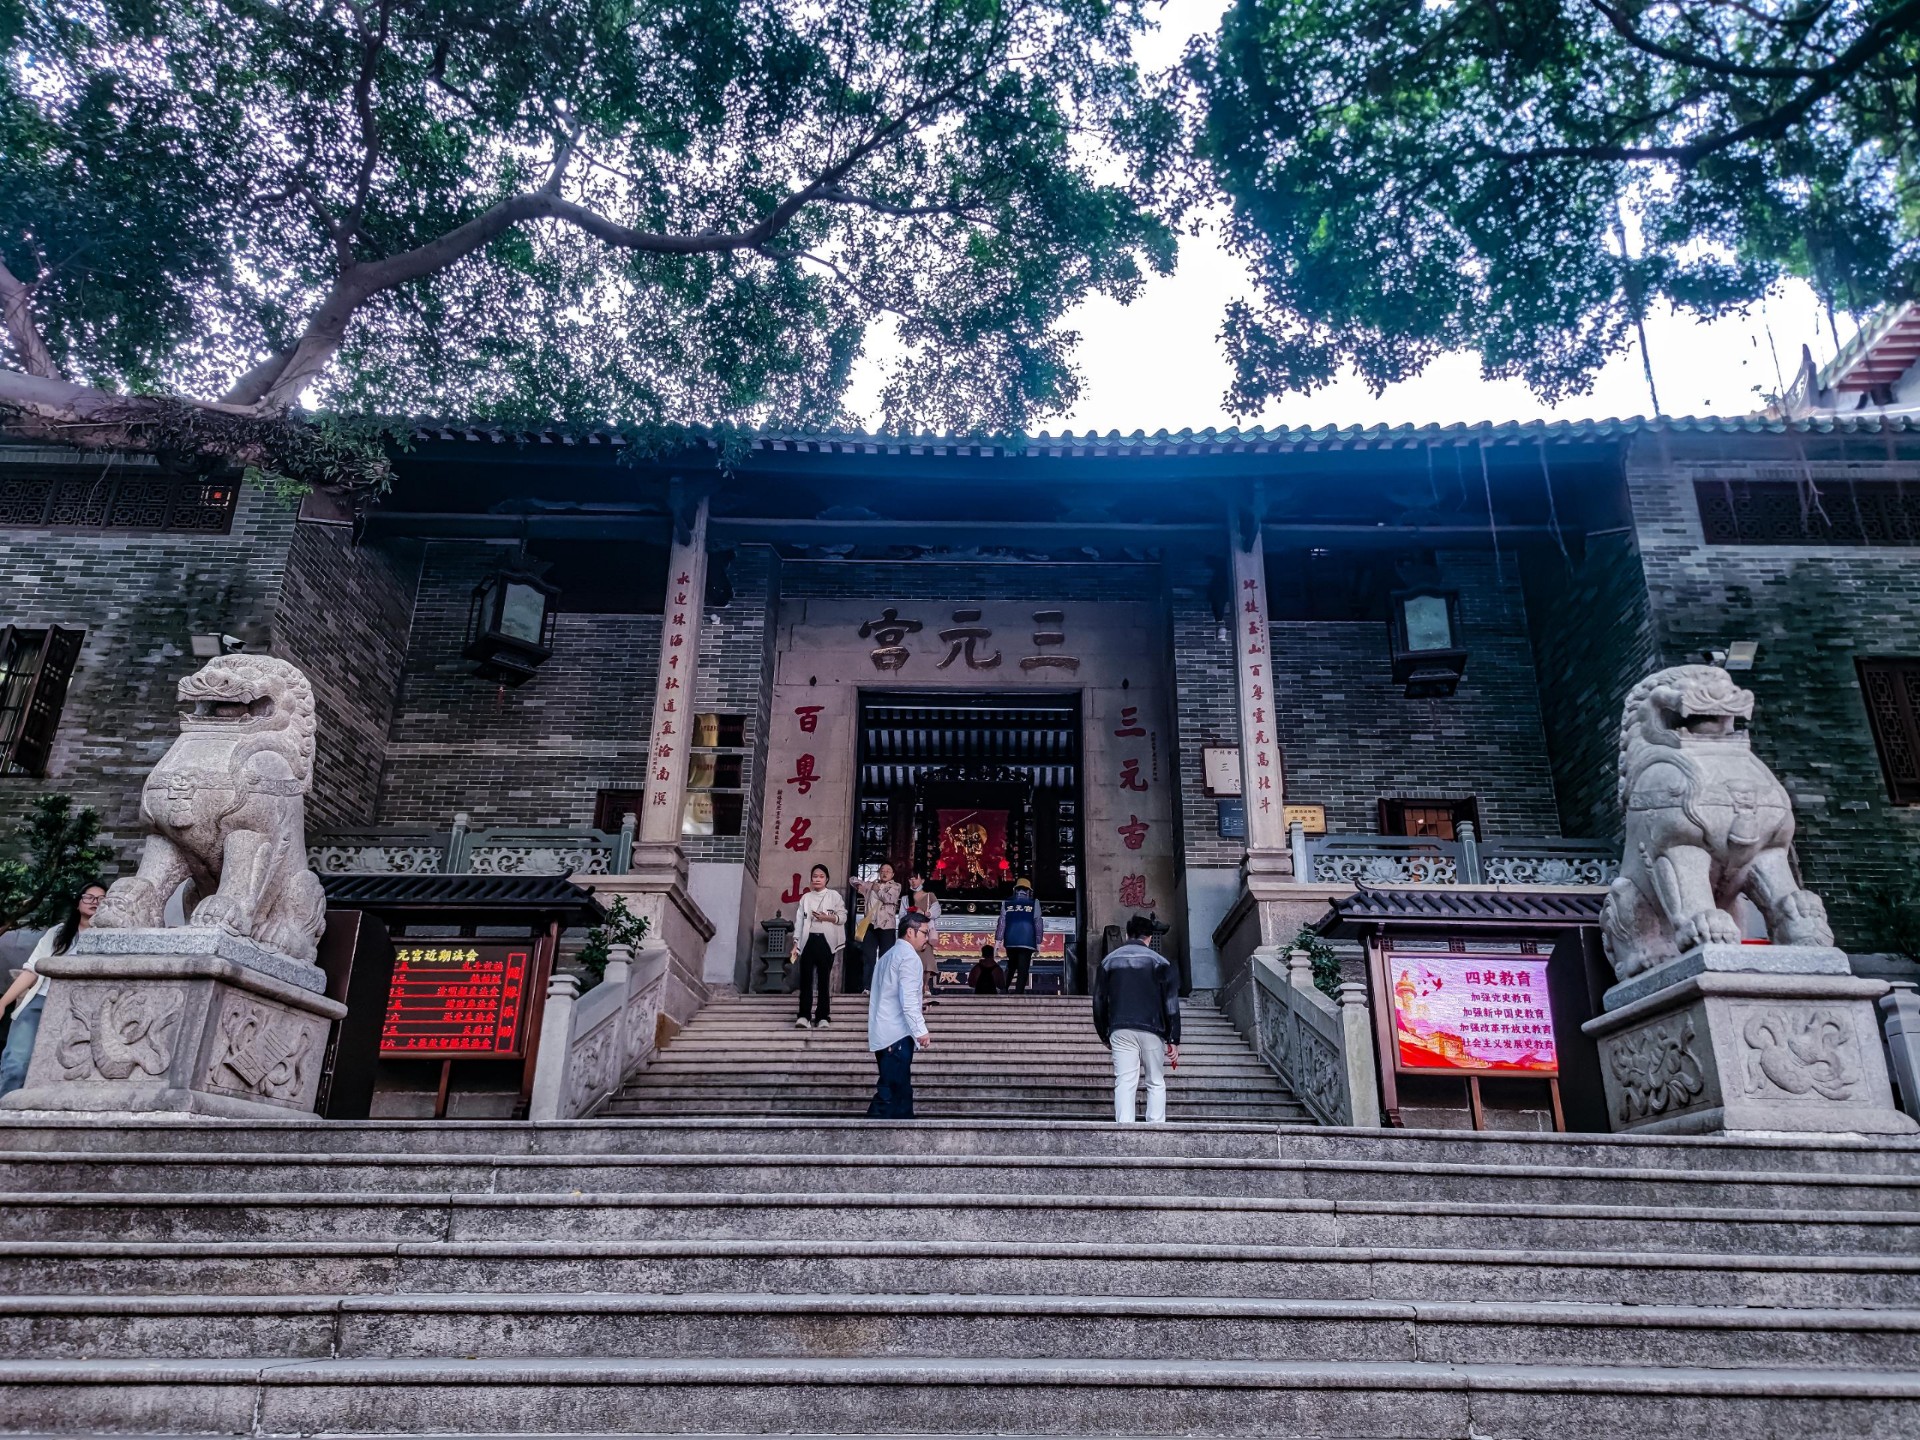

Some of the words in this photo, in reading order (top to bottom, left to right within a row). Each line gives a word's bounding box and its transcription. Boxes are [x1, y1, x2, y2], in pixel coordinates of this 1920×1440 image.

[1465, 970, 1531, 987] 四史教育
[1470, 992, 1532, 1004] 加强党史教育
[1462, 1007, 1545, 1019] 加强新中国史教育
[1459, 1022, 1552, 1035] 加强改革开放史教育
